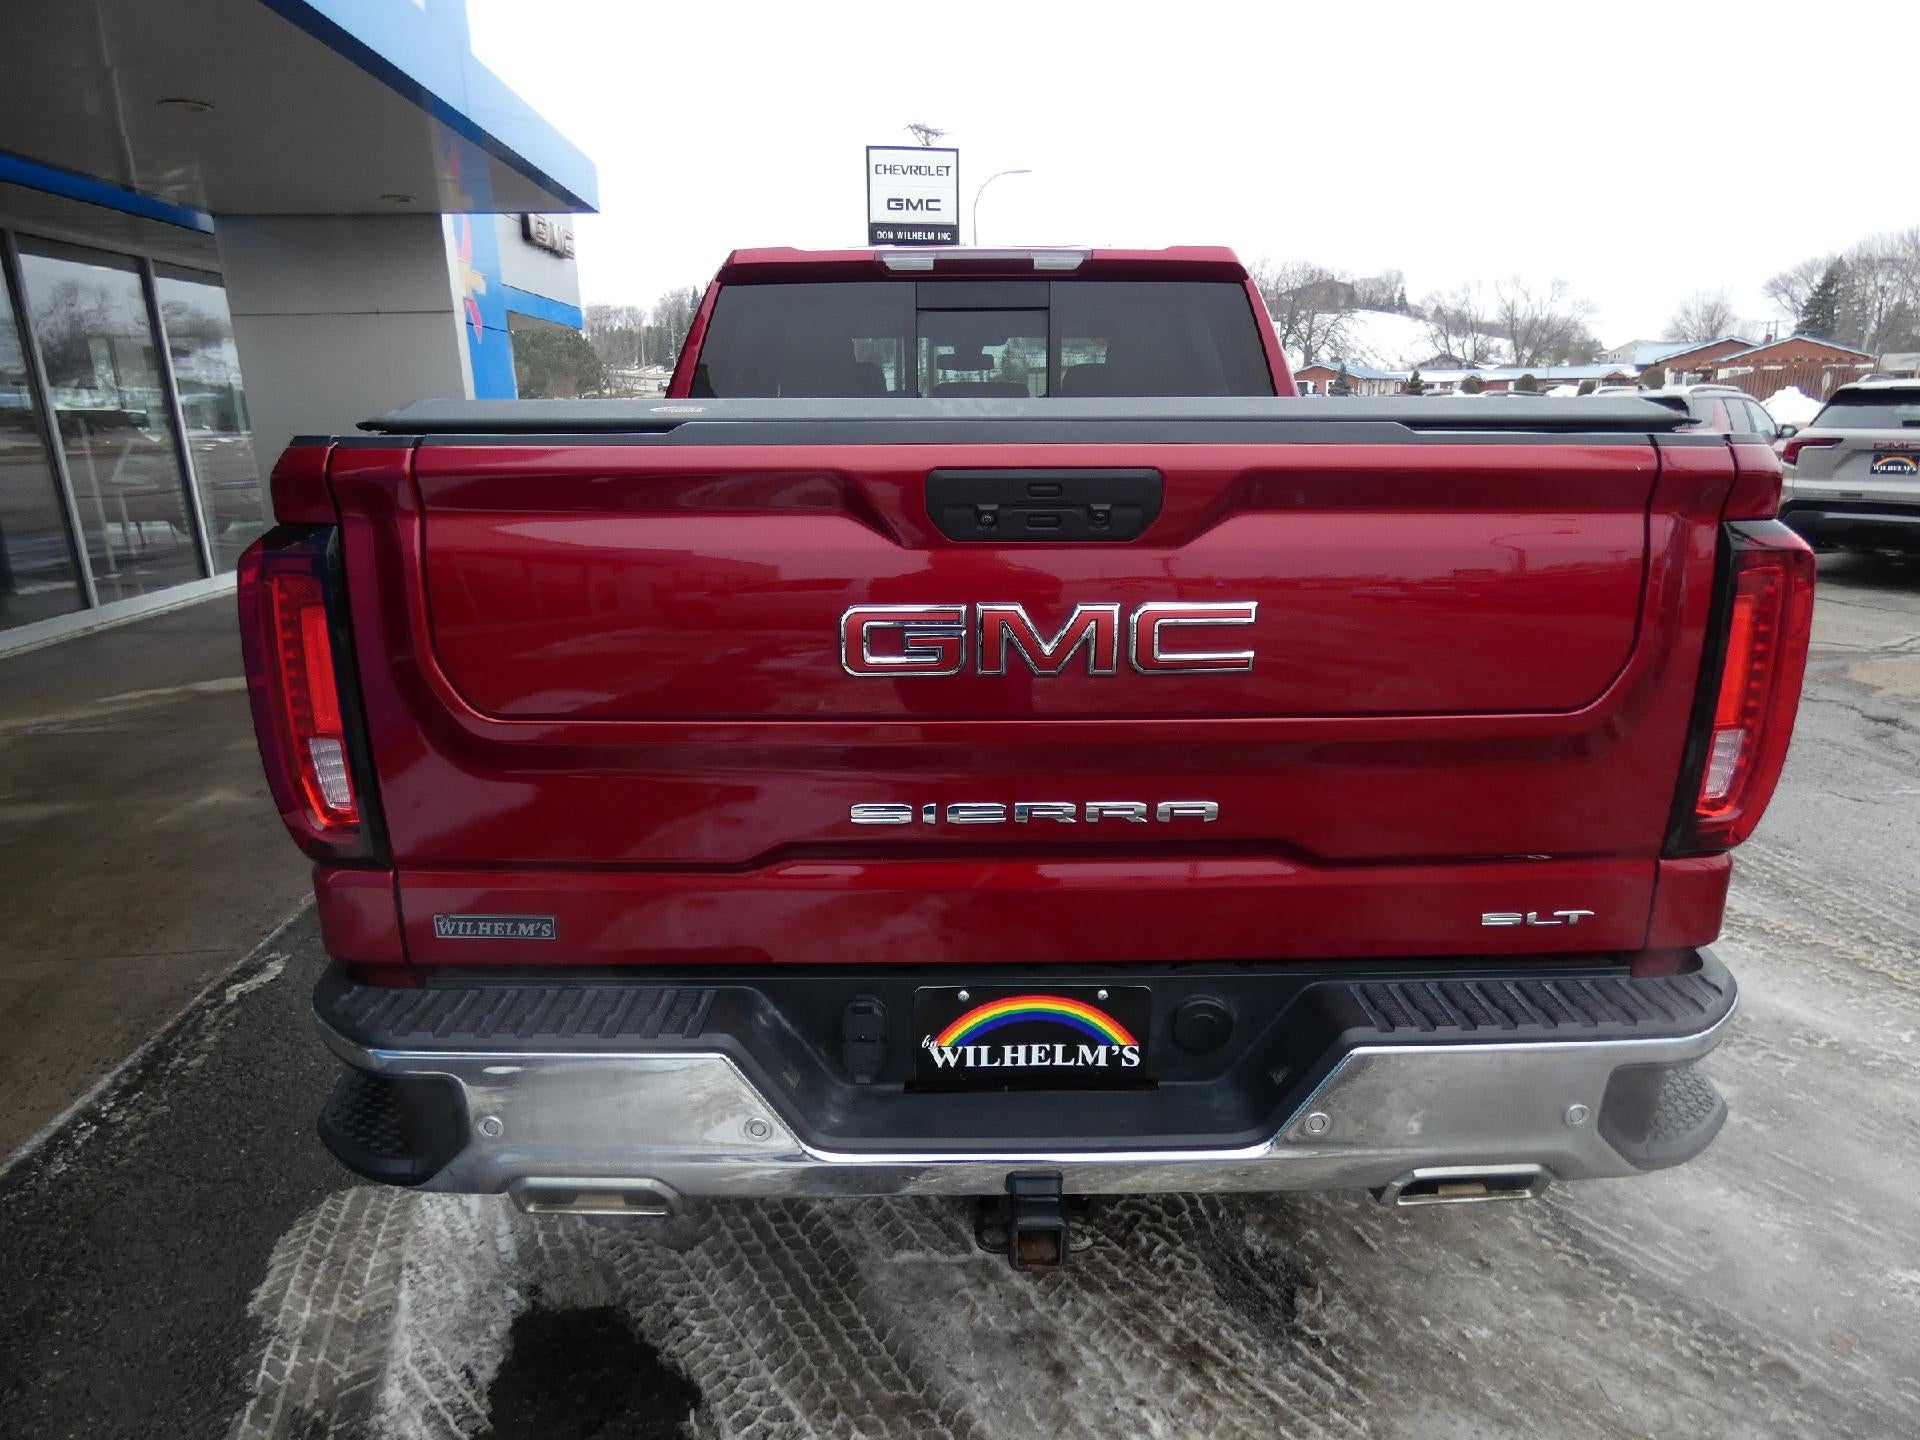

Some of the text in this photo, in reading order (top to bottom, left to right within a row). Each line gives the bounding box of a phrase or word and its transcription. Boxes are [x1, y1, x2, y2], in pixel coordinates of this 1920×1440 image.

[875, 164, 951, 176] CHEVROLET
[887, 198, 941, 211] GMC
[896, 231, 935, 241] WILHELM
[937, 232, 952, 241] INC
[838, 601, 1259, 678] GMC
[849, 800, 1220, 826] SIERRA
[1480, 909, 1596, 927] SLT
[438, 921, 553, 938] WILHELM'S
[928, 1045, 1141, 1068] WILHELM'S
